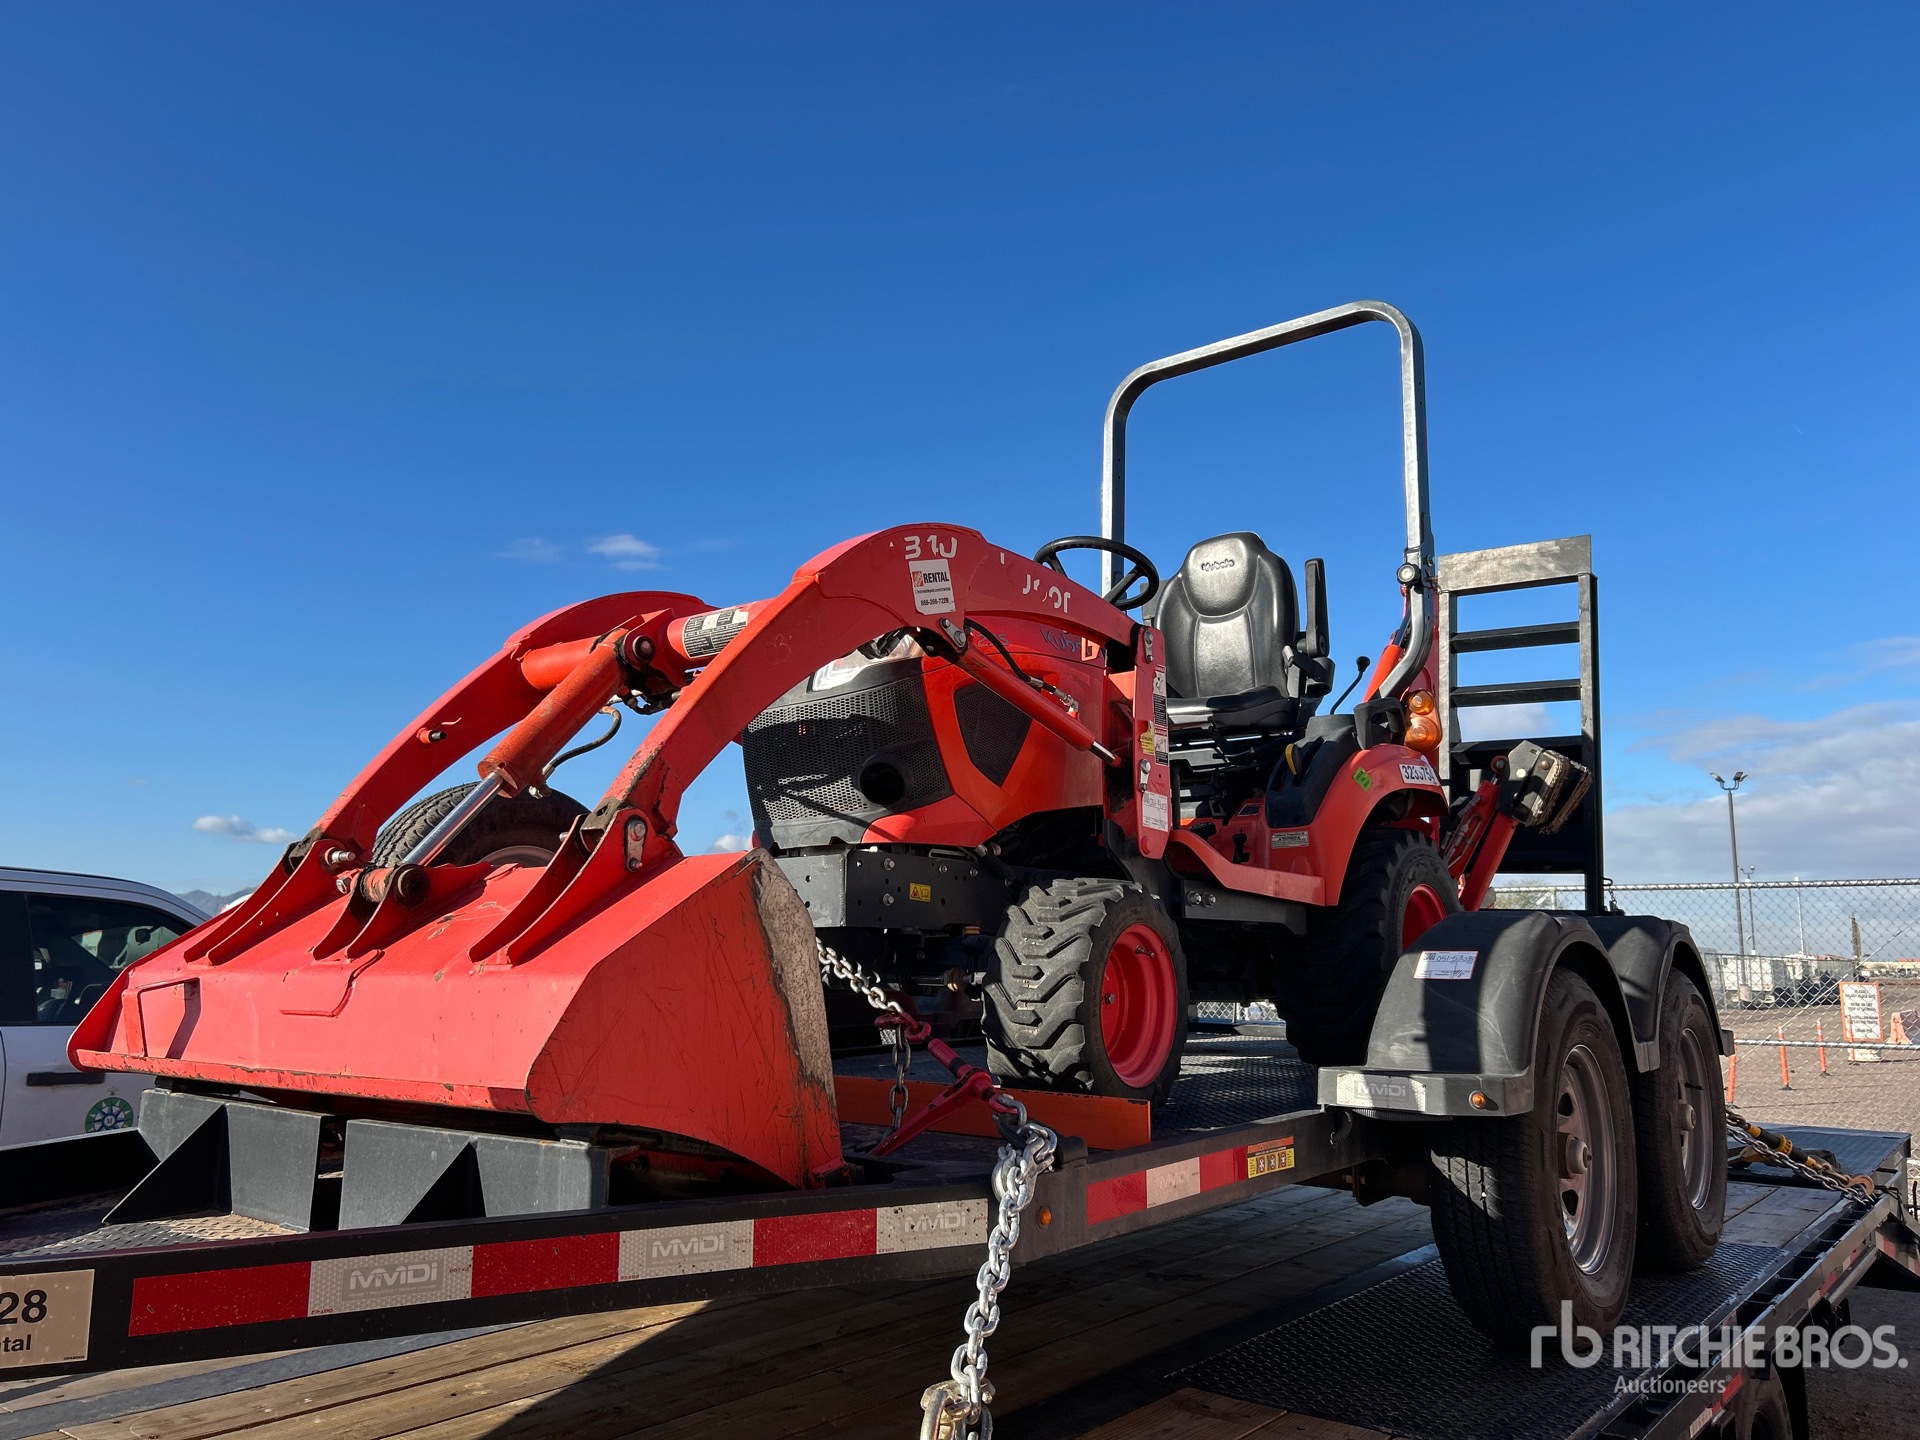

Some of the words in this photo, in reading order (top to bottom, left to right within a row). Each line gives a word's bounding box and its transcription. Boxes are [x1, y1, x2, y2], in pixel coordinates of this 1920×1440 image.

[923, 571, 950, 584] RENTAL
[0, 1289, 48, 1325] 28
[0, 1334, 32, 1352] tal
